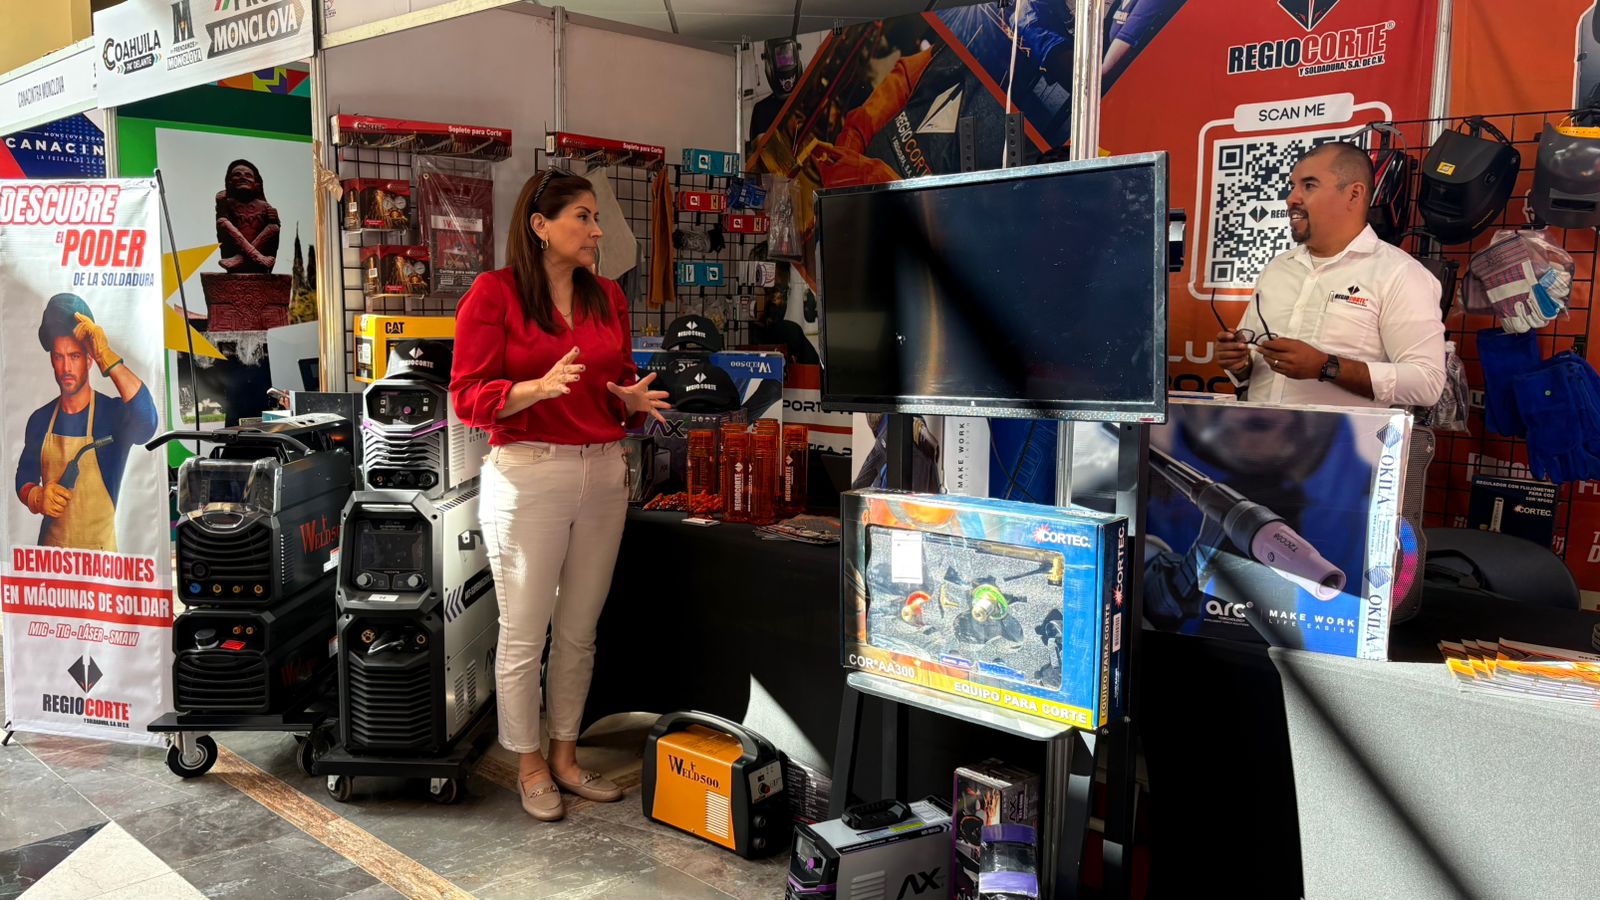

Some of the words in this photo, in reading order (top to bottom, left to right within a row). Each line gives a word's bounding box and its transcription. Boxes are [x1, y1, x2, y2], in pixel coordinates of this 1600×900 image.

[213, 4, 298, 52] MONCLOVA
[102, 30, 162, 71] COAHUILA
[167, 47, 203, 71] MONCLOVA
[1227, 23, 1387, 75] REGIOCORTE
[1298, 67, 1304, 77] Y
[1362, 57, 1372, 67] DE
[17, 84, 42, 108] CANACINTRA
[41, 75, 65, 99] MONCLOVA
[1258, 106, 1300, 122] SCAN
[1304, 103, 1326, 117] ME
[448, 125, 471, 135] Soplete
[471, 128, 485, 136] para
[0, 184, 121, 225] DESCUBRE
[61, 229, 147, 268] PODER
[73, 272, 85, 286] DE
[87, 273, 98, 286] LA
[101, 272, 155, 287] SOLDADURA
[385, 321, 405, 334] CAT
[1376, 454, 1395, 505] OKILA
[1518, 506, 1551, 516] CORTEC
[1041, 531, 1089, 547] CORTEC
[13, 549, 155, 582] DEMOSTRACIONES
[1116, 528, 1125, 593] CORTEC
[3, 584, 19, 604] EN
[24, 582, 96, 610] MÁQUINAS
[98, 593, 113, 613] DE
[116, 595, 169, 618] SOLDAR
[28, 621, 49, 636] MIG
[56, 624, 72, 638] TIG
[77, 623, 104, 642] LÁSER
[109, 631, 140, 646] SMAW
[1268, 619, 1296, 627] LIFE
[1307, 623, 1355, 634] EASIER
[1269, 609, 1306, 621] MAKE
[1314, 614, 1356, 628] WORK
[1366, 595, 1383, 642] OKILA
[42, 694, 129, 721] REGIOCORTE
[953, 682, 1000, 702] EQUIPO
[1003, 695, 1038, 712] PARA
[1042, 703, 1088, 724] CORTE
[1101, 678, 1109, 720] EQUIPO
